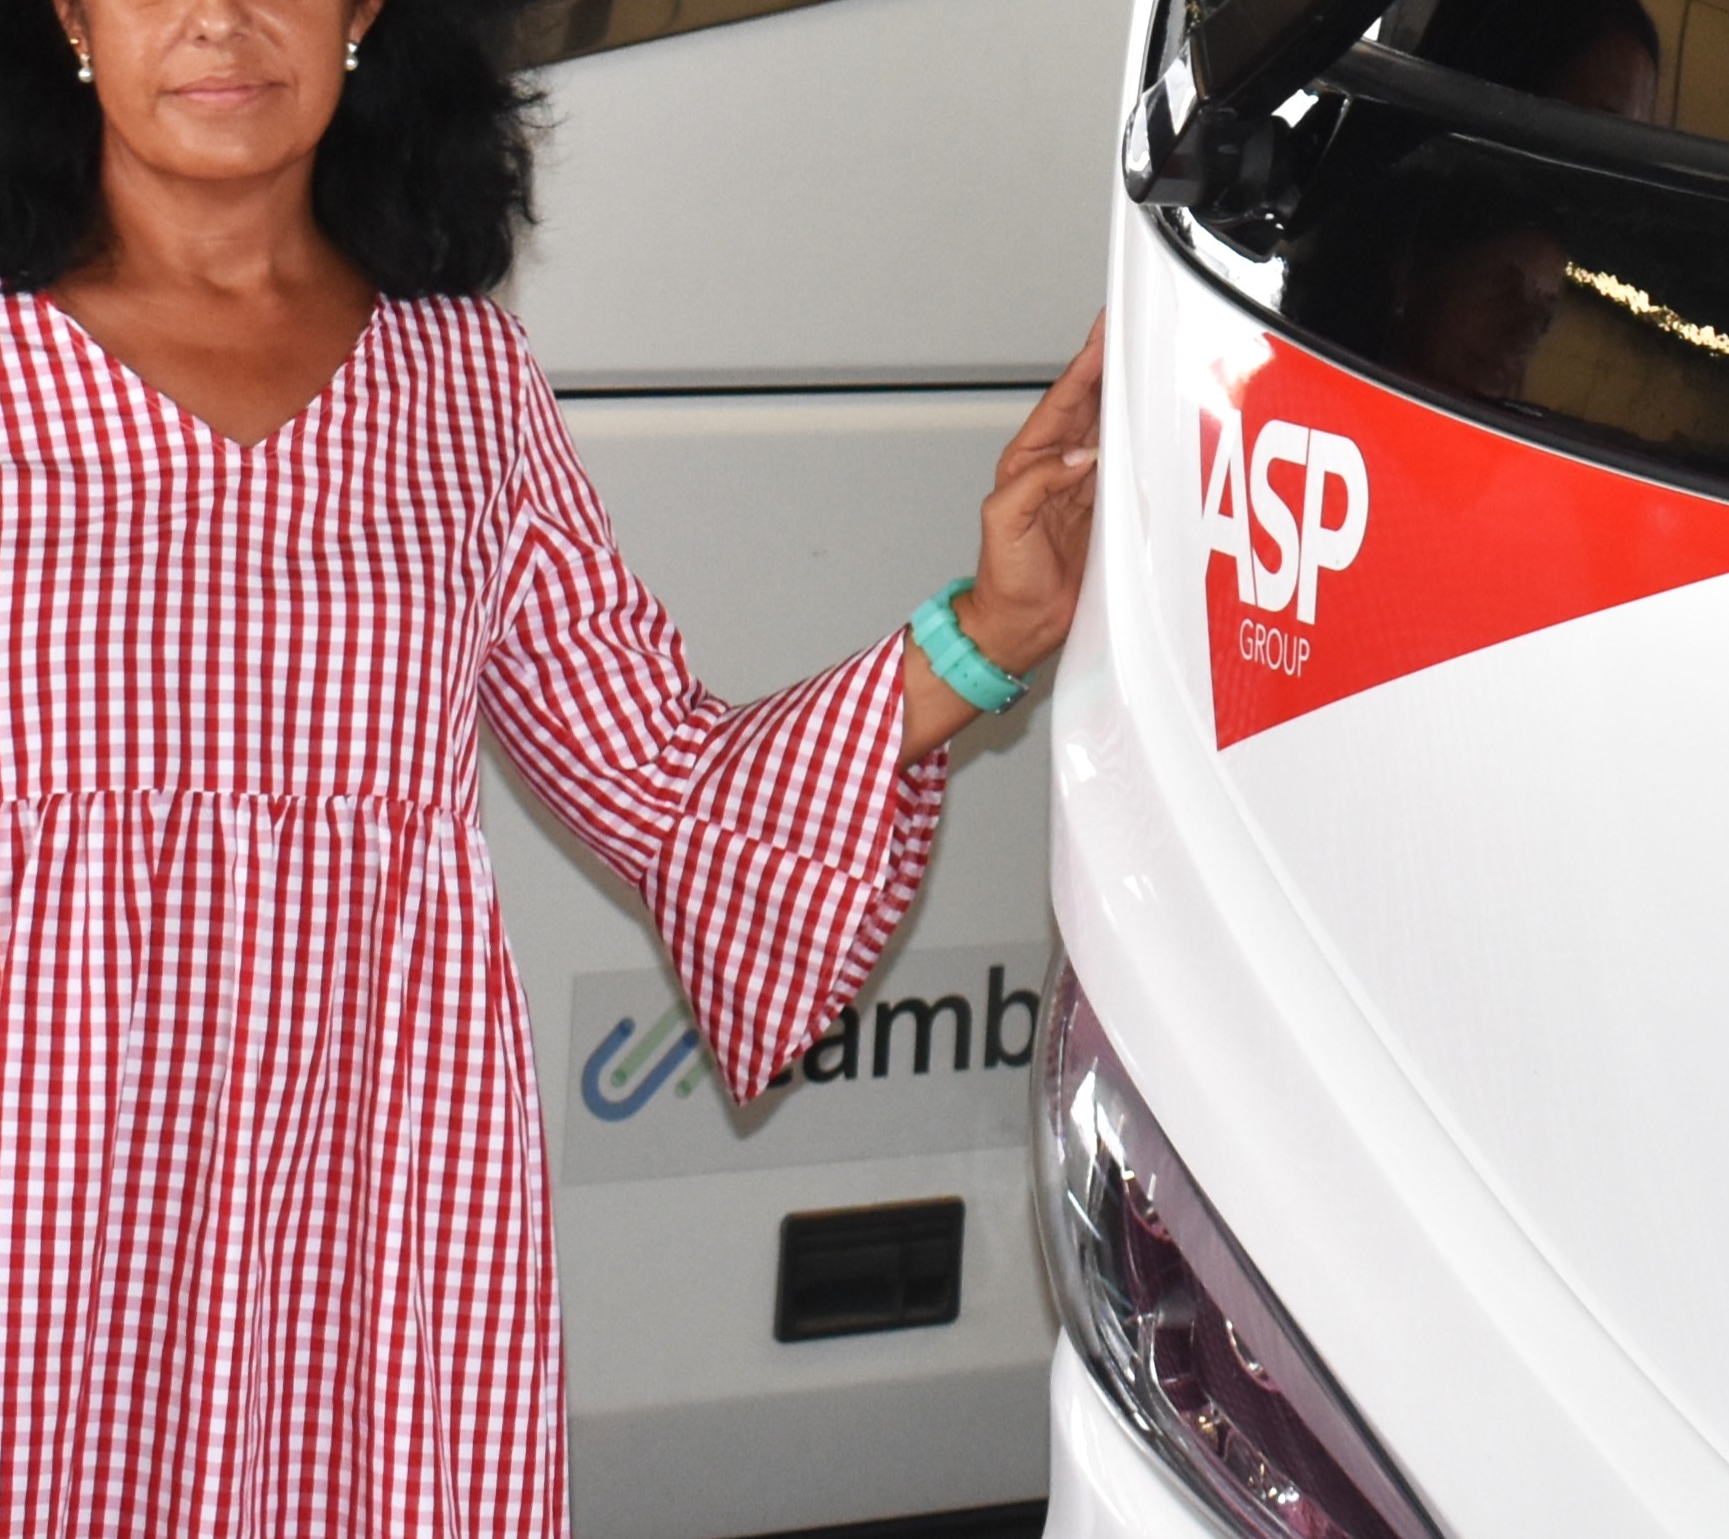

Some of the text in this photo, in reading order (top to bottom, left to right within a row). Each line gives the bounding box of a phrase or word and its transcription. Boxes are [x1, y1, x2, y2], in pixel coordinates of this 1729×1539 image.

[1199, 408, 1369, 626] ASP
[1239, 617, 1311, 677] GROUP
[767, 965, 1041, 1089] amb
